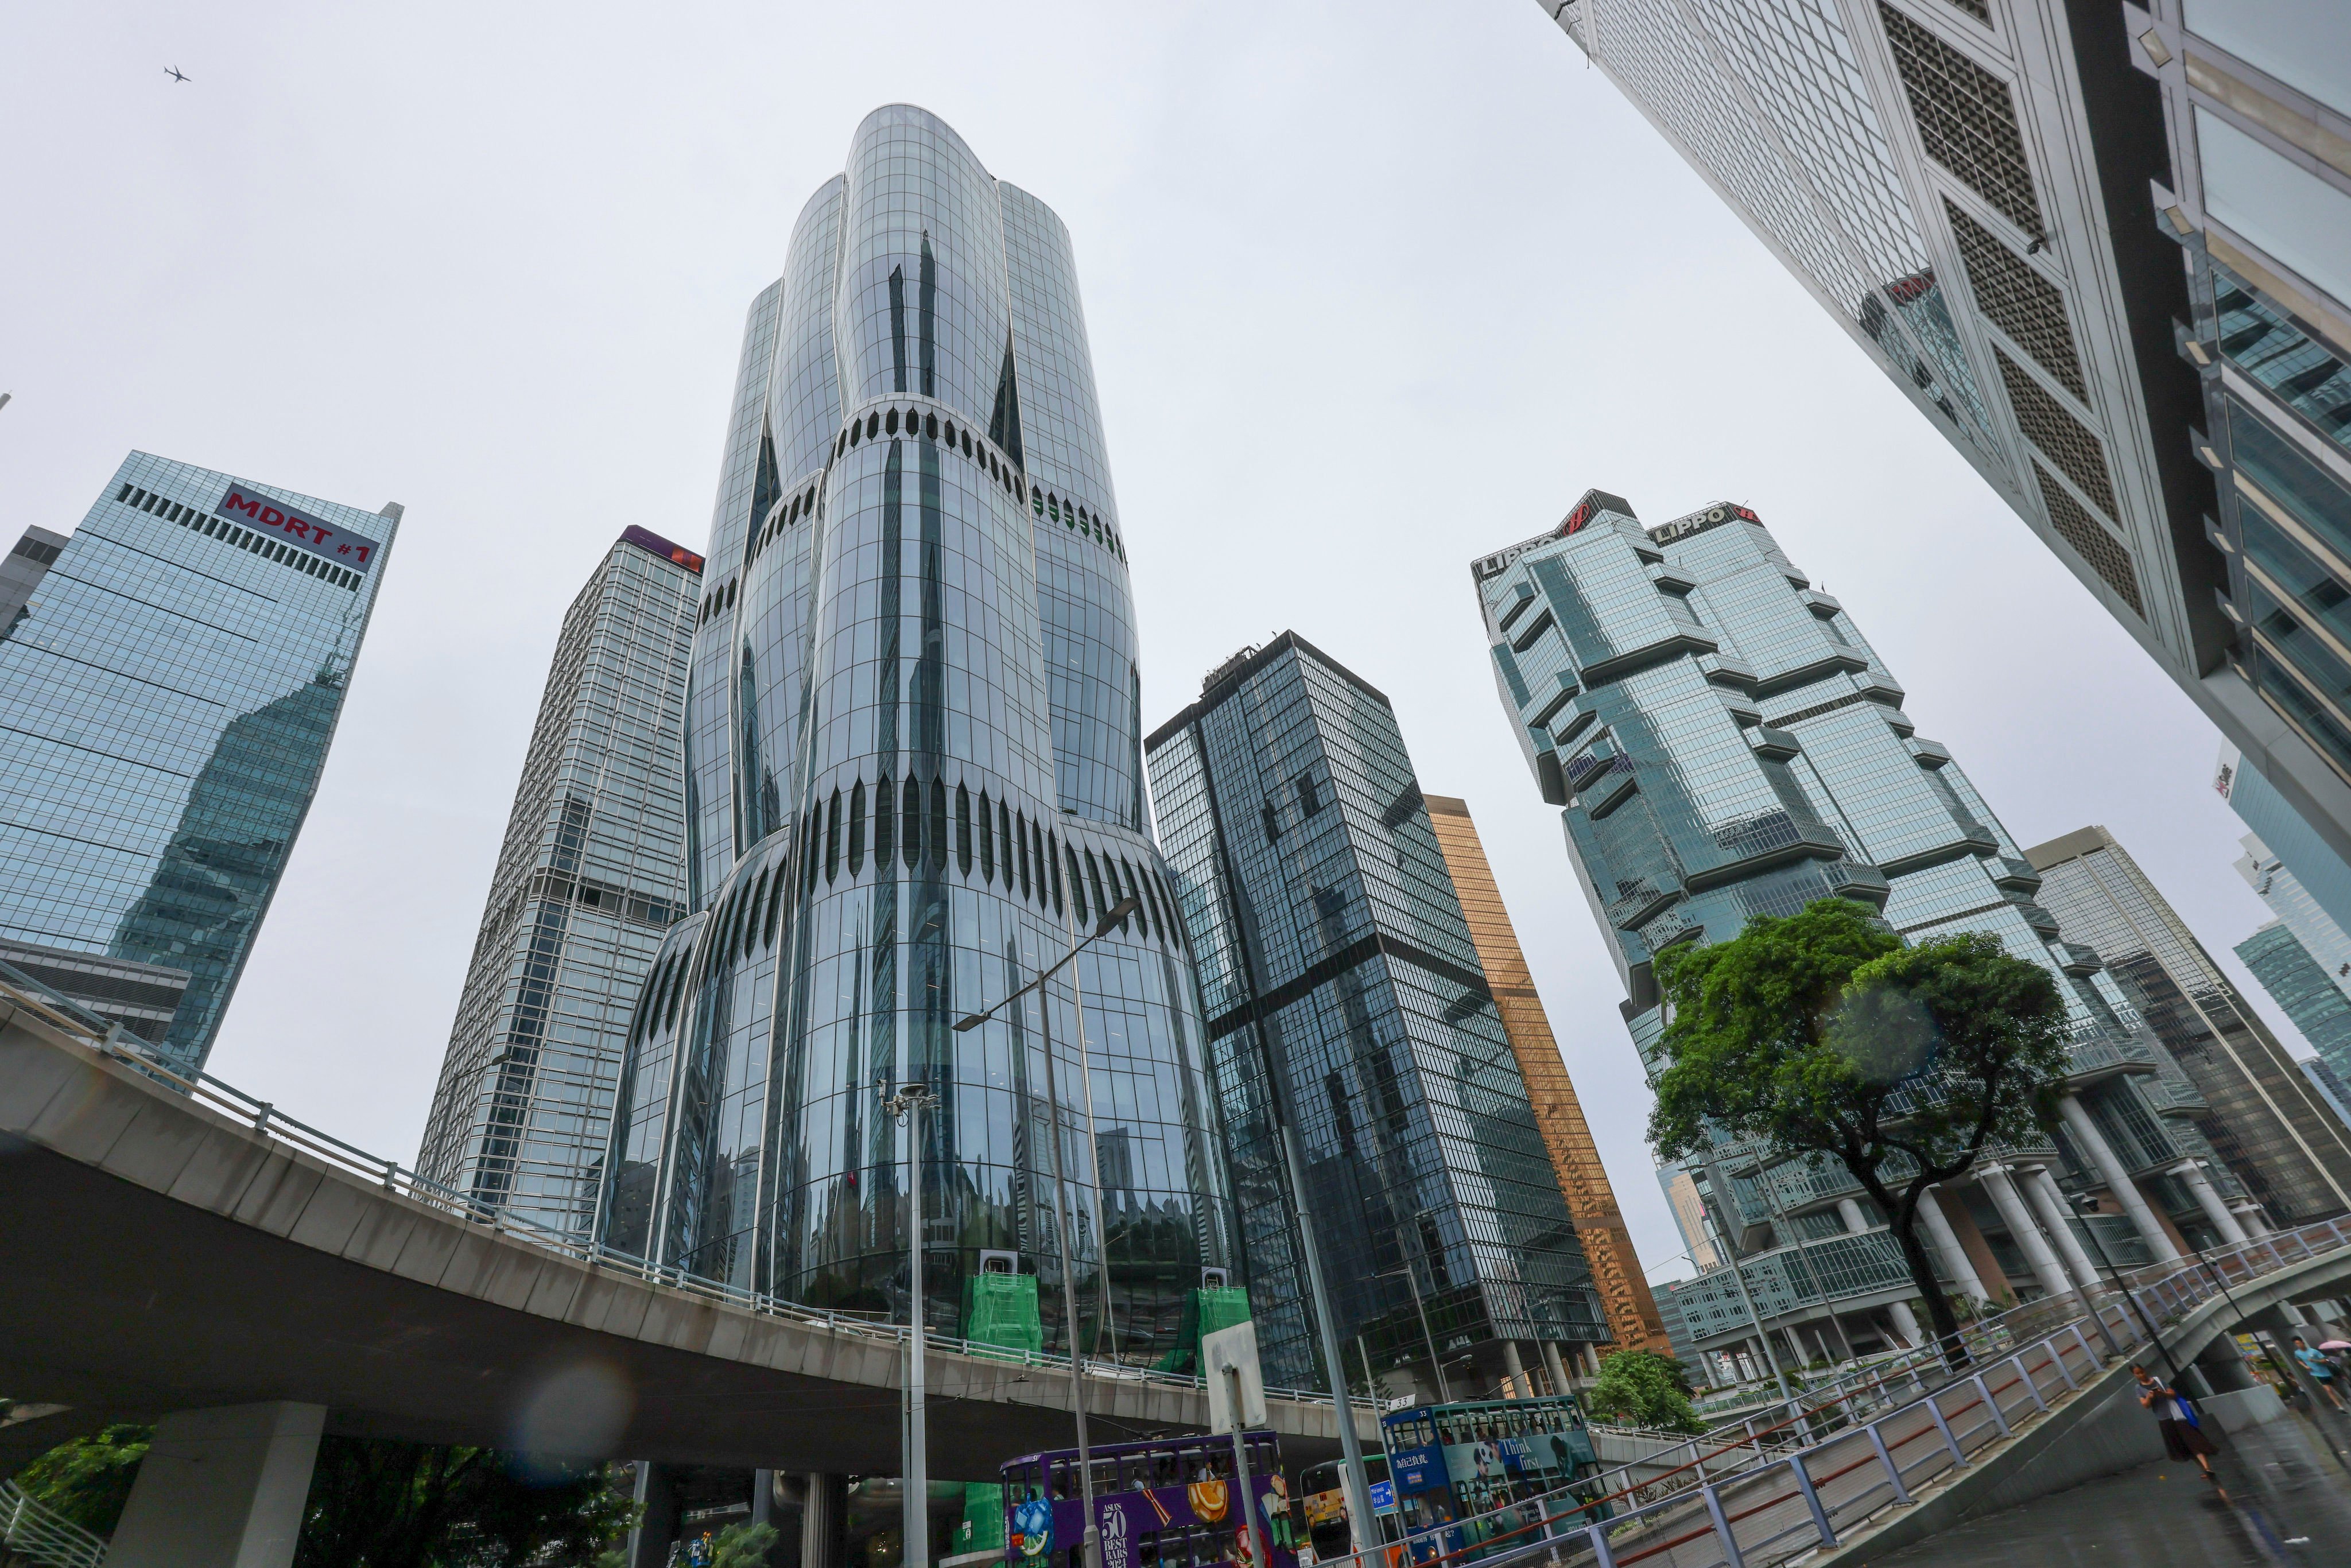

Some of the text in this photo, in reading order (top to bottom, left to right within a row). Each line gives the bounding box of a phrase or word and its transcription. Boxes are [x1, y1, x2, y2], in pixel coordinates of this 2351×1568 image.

[224, 492, 370, 563] MDRT #1
[1655, 508, 1725, 543] LIPPO
[1396, 1397, 1407, 1408] 33
[1501, 1438, 1532, 1456] Think
[1519, 1454, 1543, 1470] first.
[1103, 1503, 1122, 1512] ASIA'S
[1102, 1510, 1127, 1540] 50
[1104, 1537, 1127, 1551] BEST
[1105, 1548, 1128, 1561] BARS
[1107, 1558, 1127, 1568] 2024
